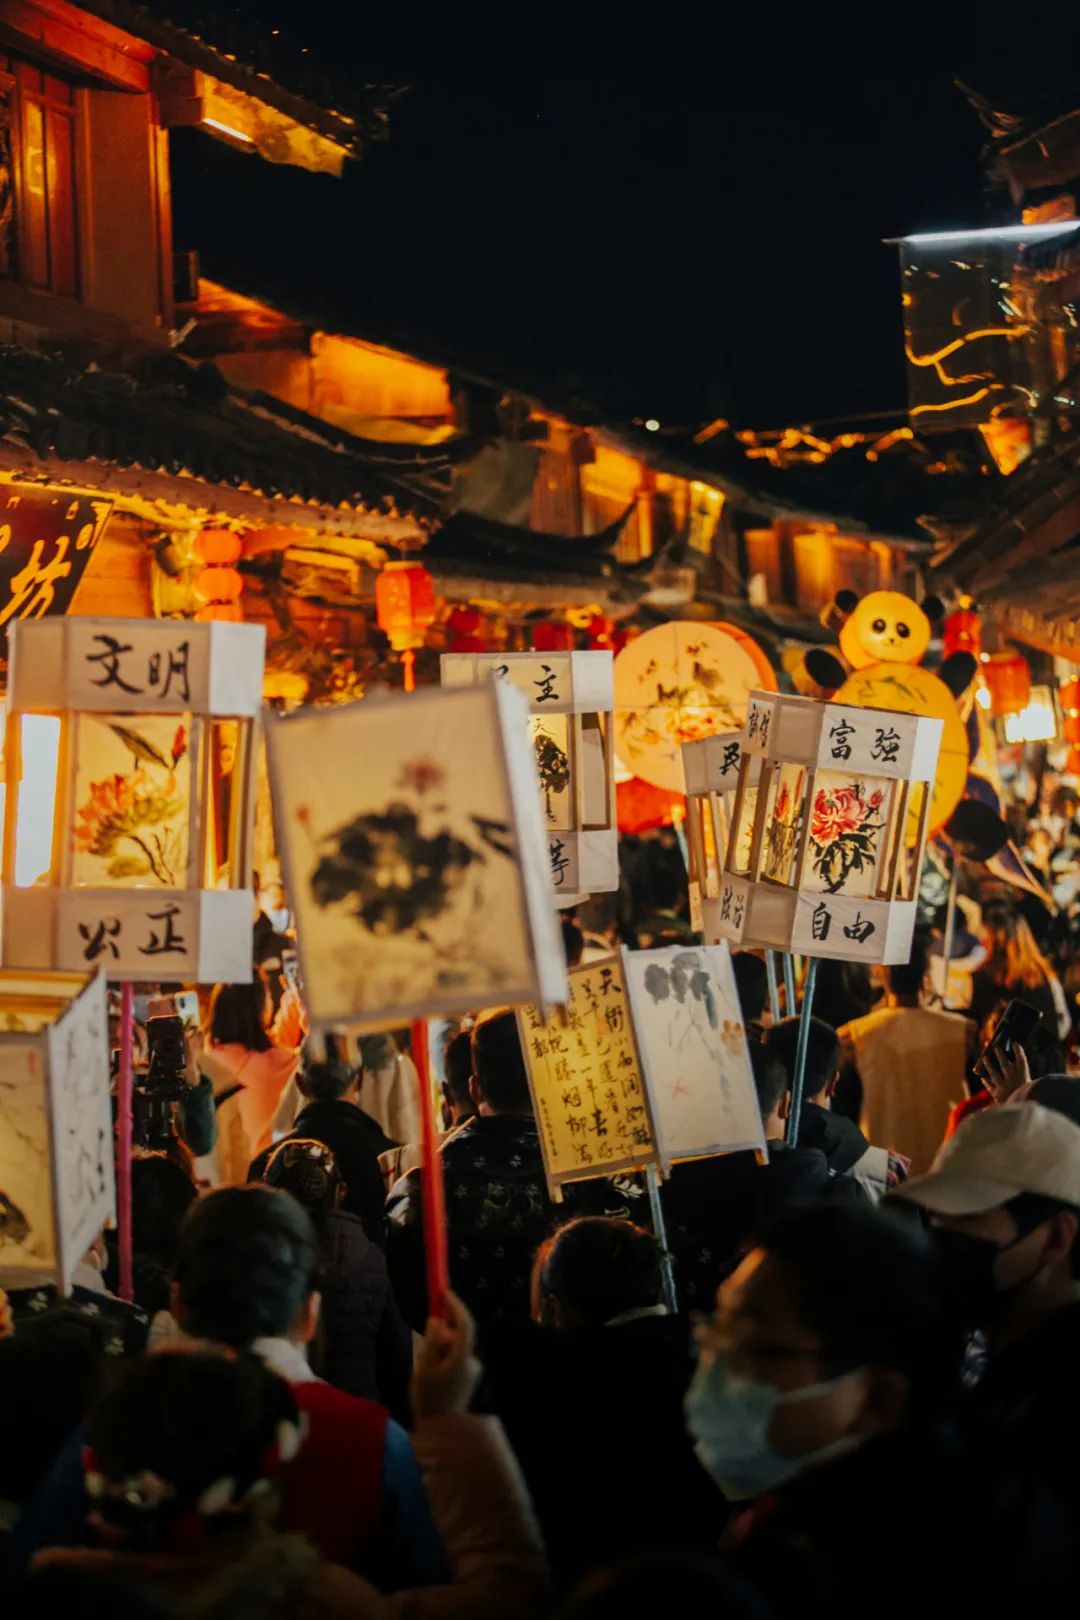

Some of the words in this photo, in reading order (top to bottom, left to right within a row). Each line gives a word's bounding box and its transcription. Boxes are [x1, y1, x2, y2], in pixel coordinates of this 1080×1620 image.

[86, 635, 191, 703] 文明
[78, 903, 189, 962] 公正
[811, 902, 876, 946] 自由
